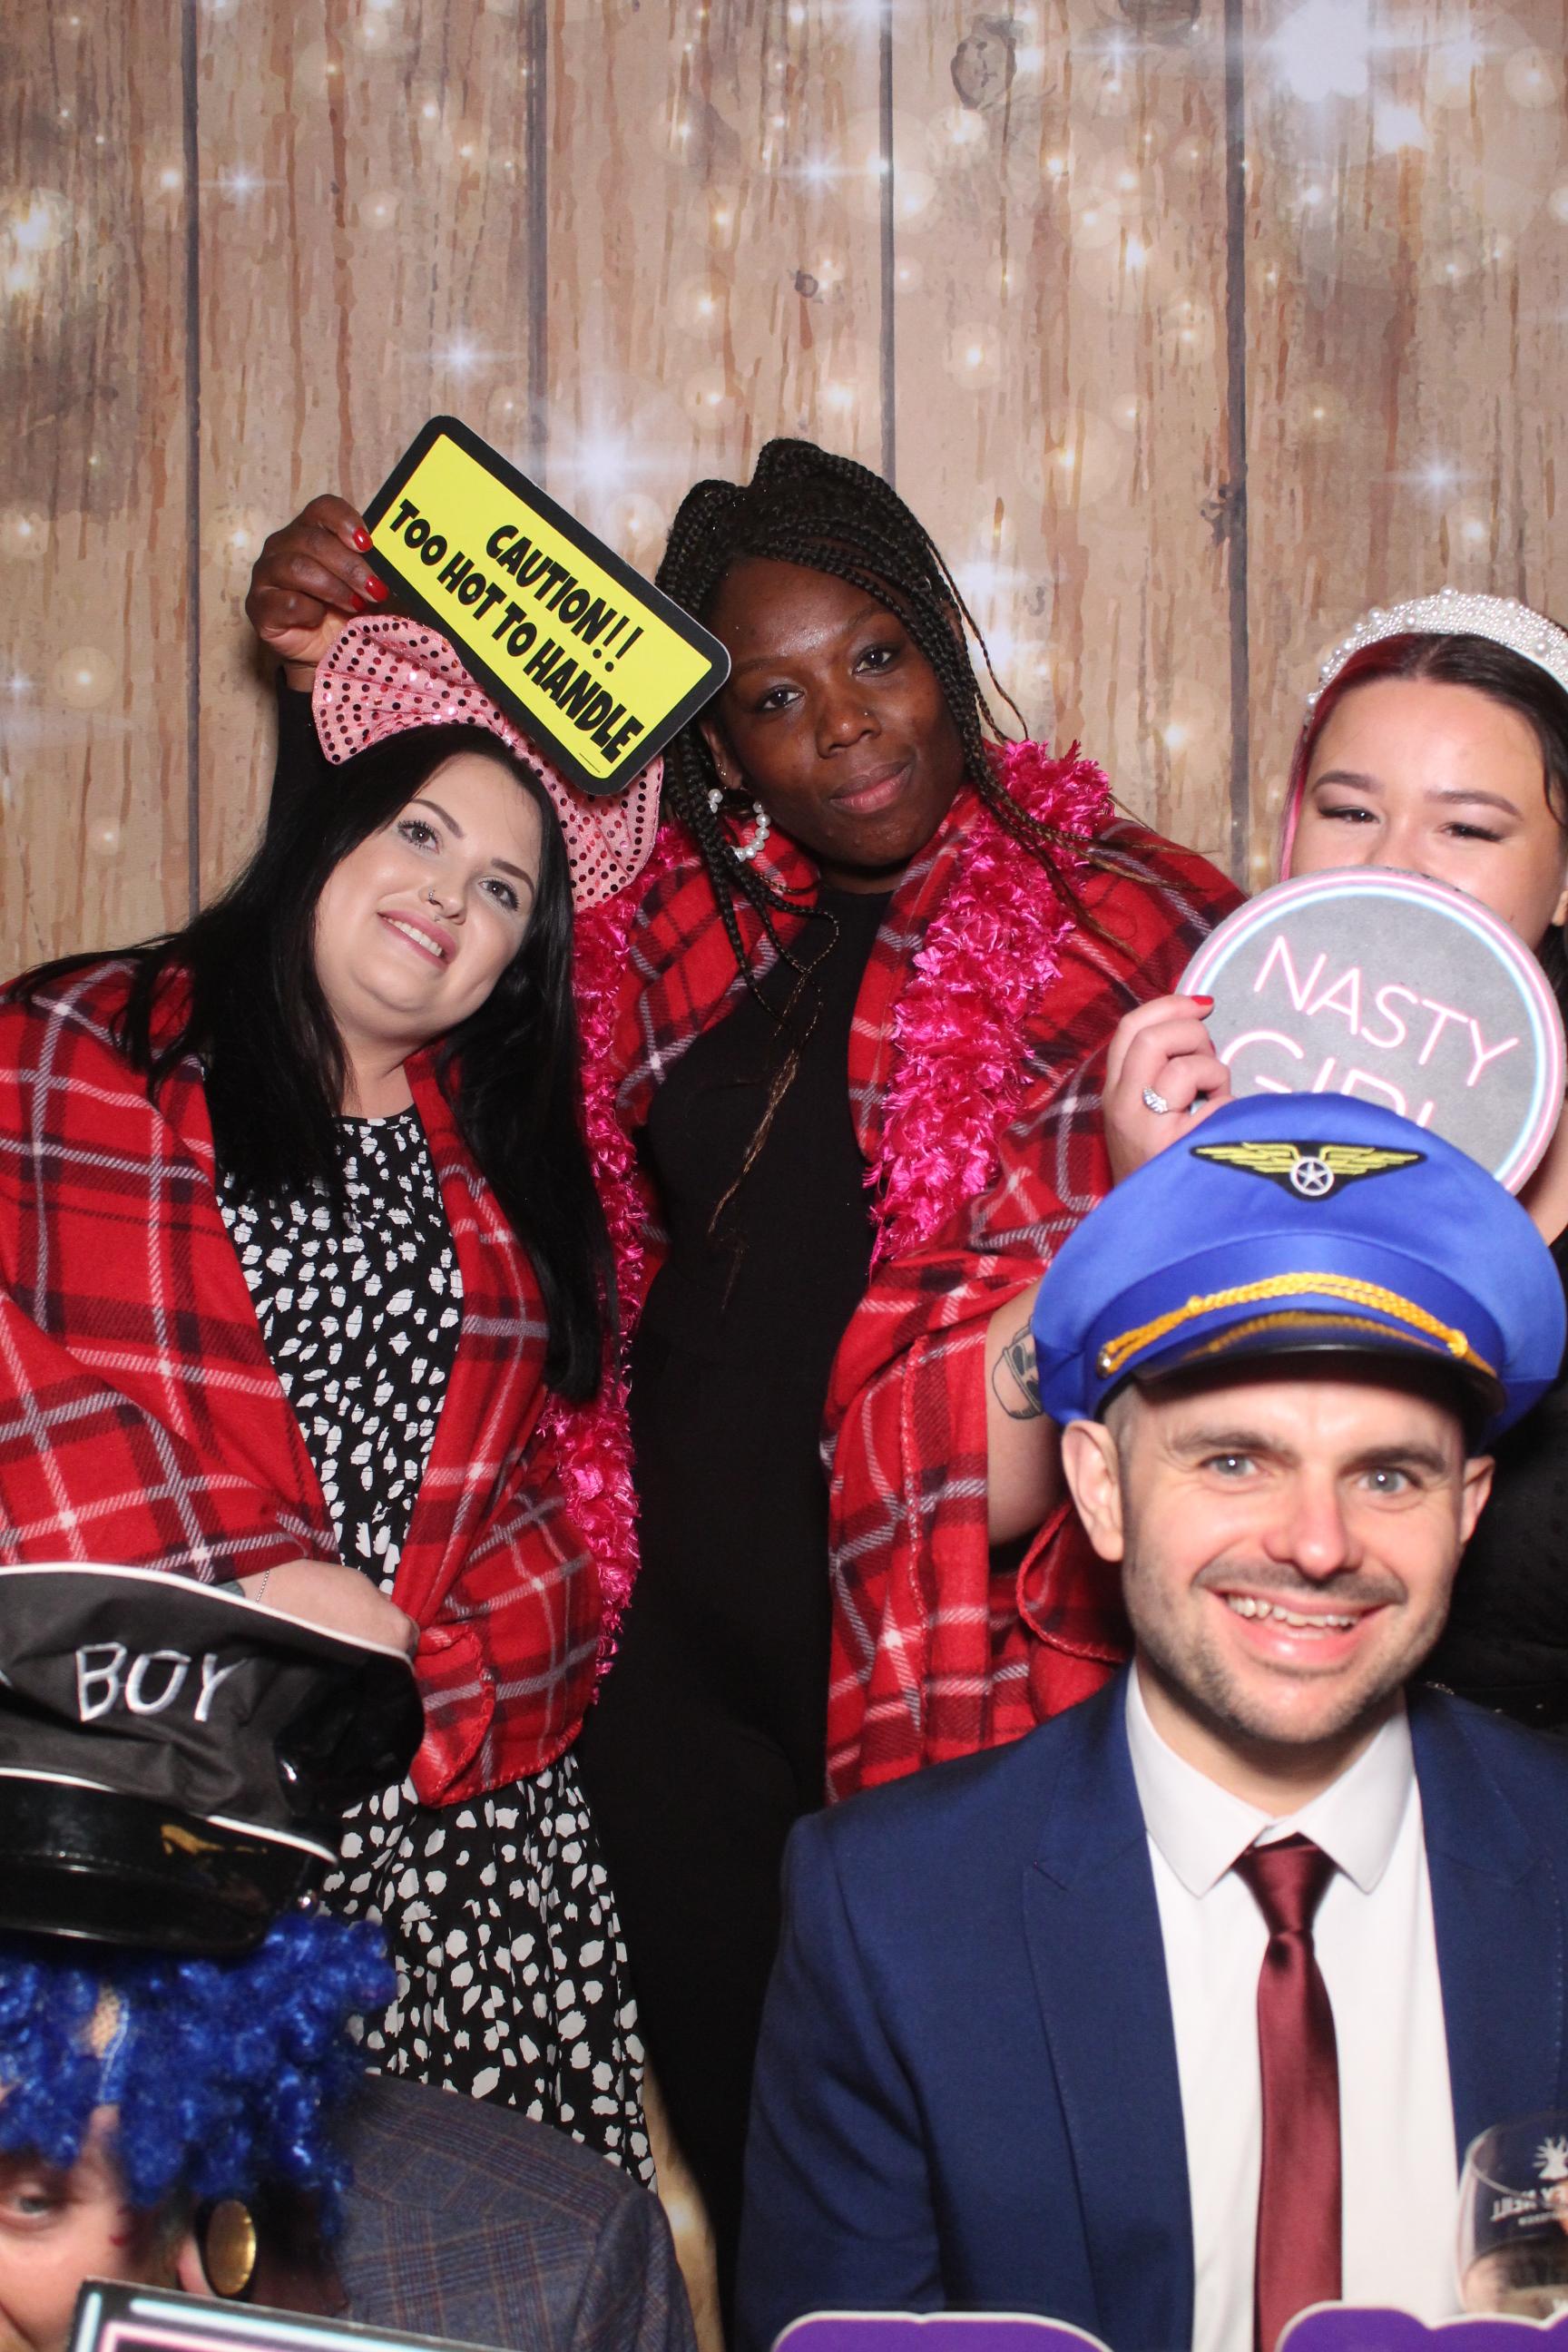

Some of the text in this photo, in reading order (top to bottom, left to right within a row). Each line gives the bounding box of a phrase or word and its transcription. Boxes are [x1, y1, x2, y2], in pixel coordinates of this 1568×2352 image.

[390, 499, 644, 763] TOO HOT TO HANDLE
[486, 525, 644, 672] CAUTION!!
[1253, 936, 1519, 1086] NASTY
[75, 1641, 248, 1721] BOY
